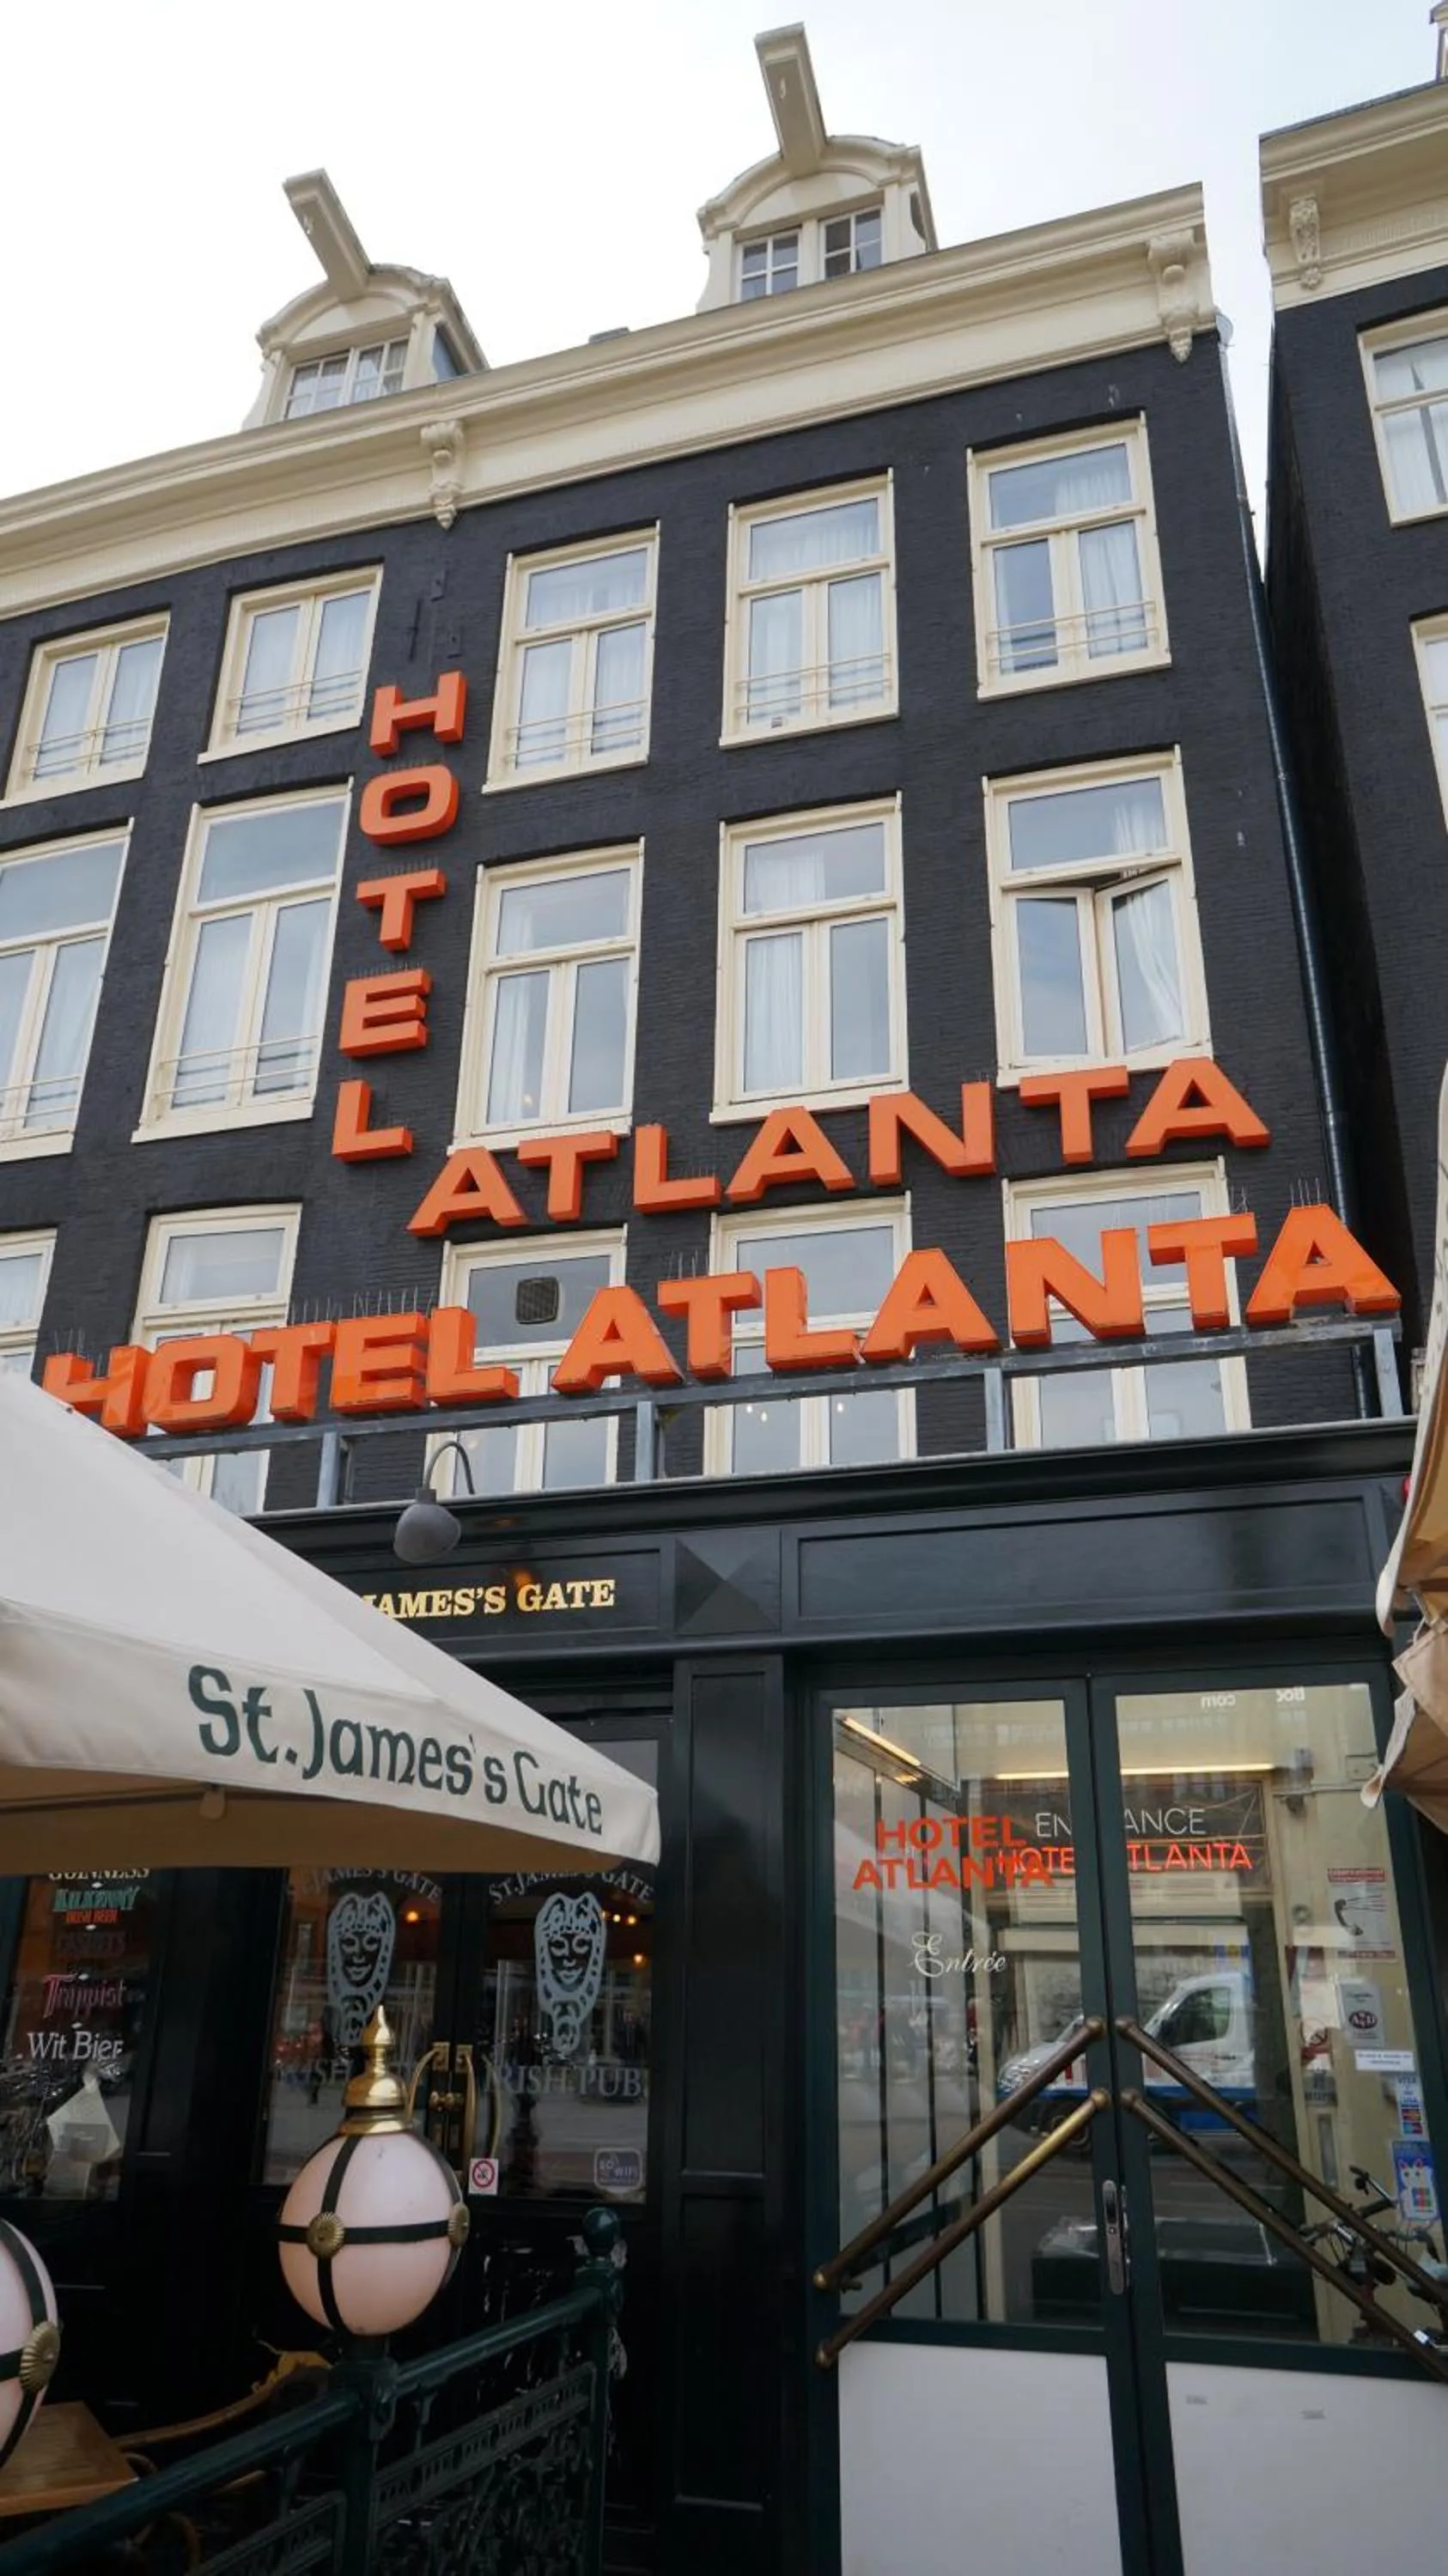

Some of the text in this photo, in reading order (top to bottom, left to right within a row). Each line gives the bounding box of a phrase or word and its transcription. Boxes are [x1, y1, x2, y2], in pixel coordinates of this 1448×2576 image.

[332, 671, 466, 1163] HOTEL
[406, 1055, 1271, 1238] ATLANTA
[42, 1306, 520, 1436] HOTEL
[551, 1203, 1402, 1395] ATLANTA
[517, 1579, 616, 1613] GATE
[514, 1750, 602, 1835] Gate
[875, 1814, 1028, 1854] HOTEL
[1036, 1807, 1207, 1838] ENANCE
[852, 1854, 1056, 1890] ATLANTA
[998, 1842, 1254, 1874] HOTE TLANTA
[393, 1868, 443, 1904] GATE
[906, 1930, 1007, 1978] Entrée
[43, 1973, 126, 2018] Trappist
[27, 2031, 68, 2060] Wit
[575, 2065, 642, 2097] PUB
